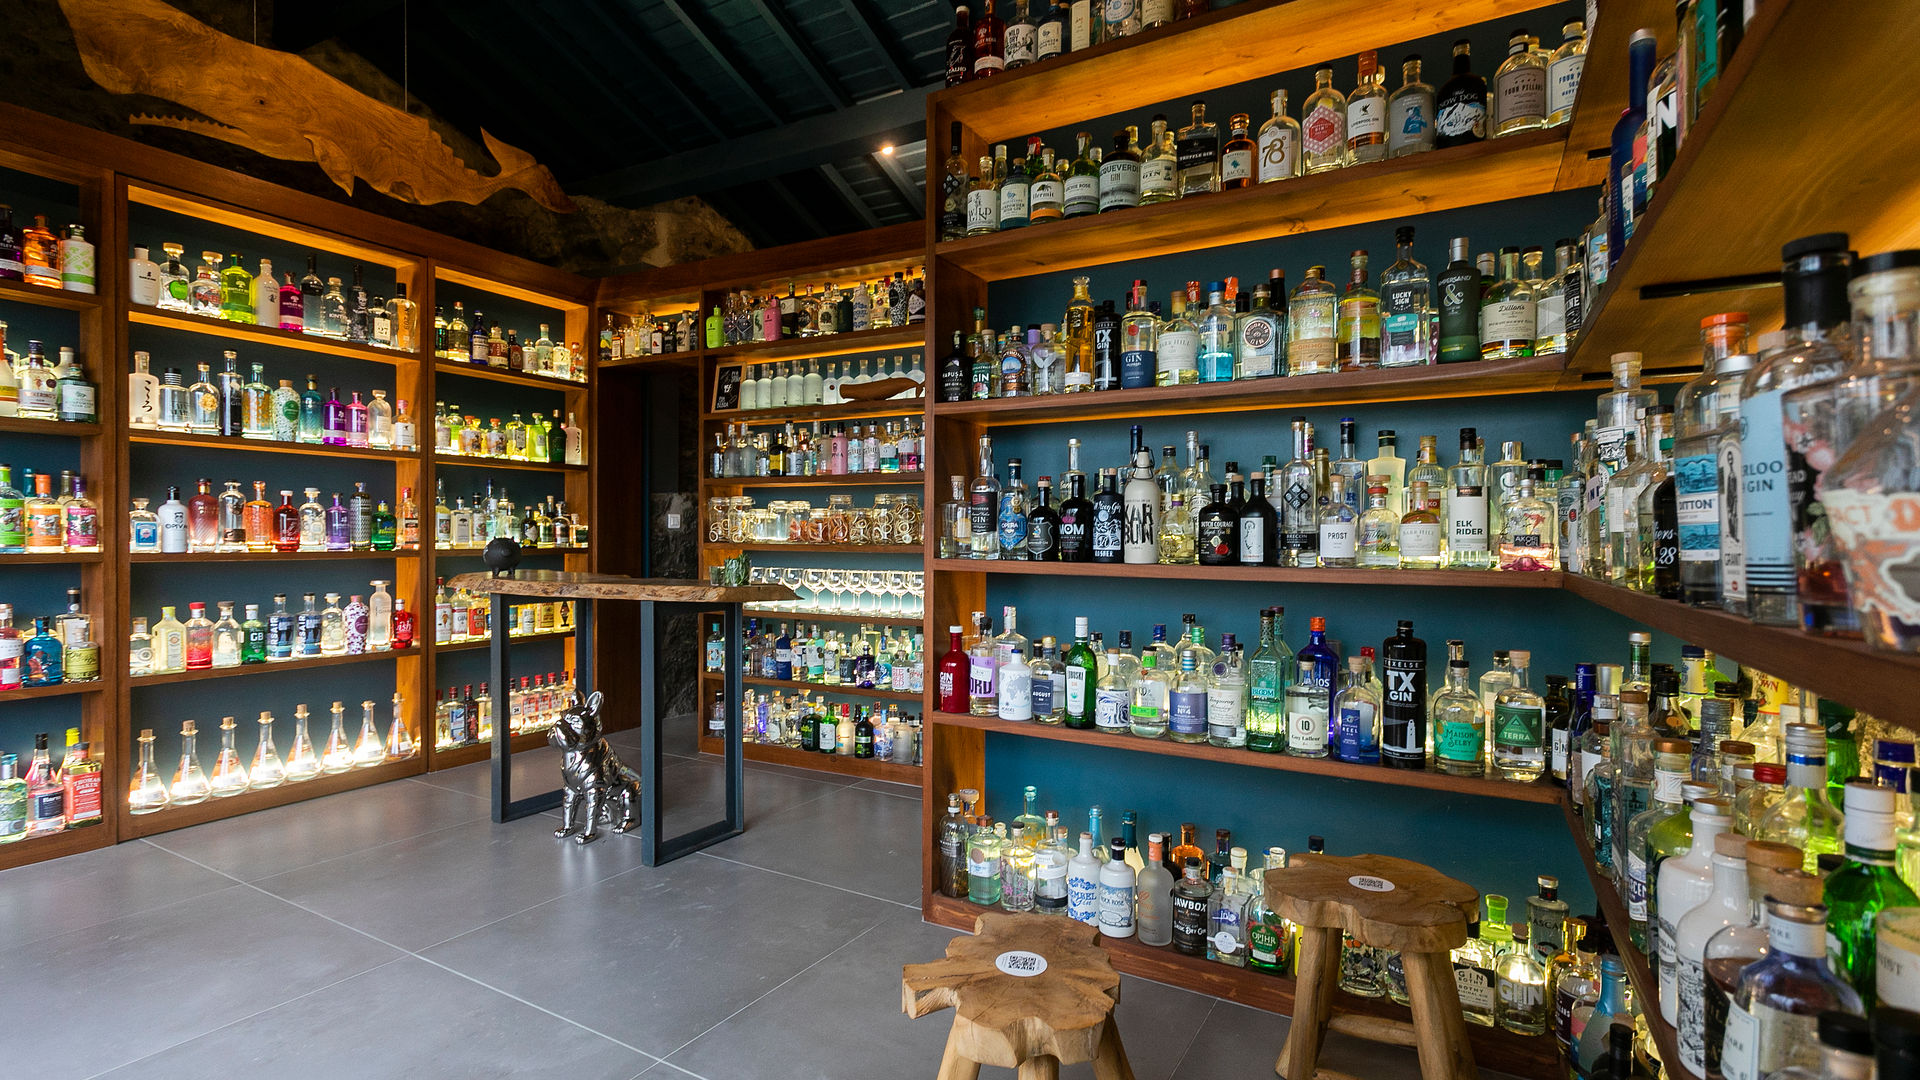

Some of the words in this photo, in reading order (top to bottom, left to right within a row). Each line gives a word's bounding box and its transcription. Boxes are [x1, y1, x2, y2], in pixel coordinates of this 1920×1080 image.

[1111, 174, 1121, 182] GIN
[1392, 292, 1412, 300] LUCKY
[1395, 298, 1410, 306] SIGN
[1096, 329, 1112, 343] TX
[1125, 355, 1143, 363] GIN
[973, 373, 990, 383] GIN
[1328, 532, 1347, 540] PROST
[251, 633, 263, 642] GB
[940, 672, 953, 682] GIN
[1387, 670, 1416, 693] TX
[1389, 691, 1413, 702] GIN
[1302, 720, 1310, 731] 10
[1444, 729, 1474, 740] MAISON
[1504, 732, 1531, 741] TERRA
[1447, 739, 1471, 748] SELBY
[1252, 932, 1276, 944] OPIHR
[1458, 971, 1484, 982] GIN
[1458, 977, 1483, 986] BOTHY
[1458, 985, 1484, 993] BOTHY
